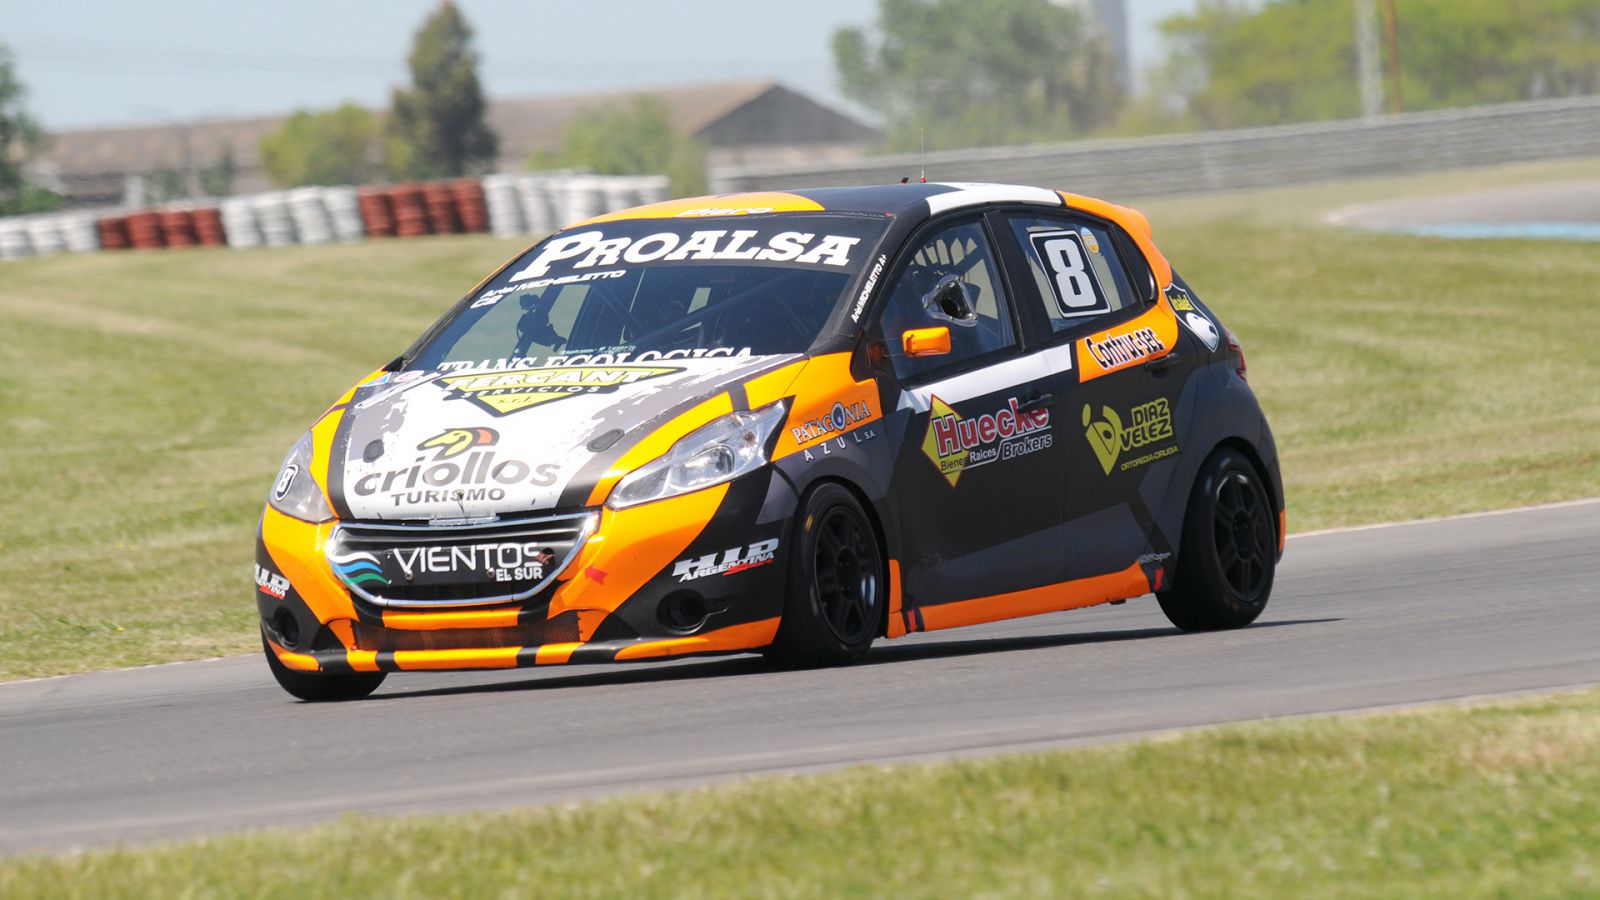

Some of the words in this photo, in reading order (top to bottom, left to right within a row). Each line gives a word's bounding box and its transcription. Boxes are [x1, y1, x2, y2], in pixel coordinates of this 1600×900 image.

[509, 230, 861, 282] PROALSA
[517, 270, 627, 291] MICHELETTO
[859, 263, 883, 310] MICHELETTO
[1043, 238, 1097, 308] 8
[1085, 326, 1166, 370] Contruc-sec
[462, 385, 601, 398] SERVICIOS
[791, 400, 871, 445] PATAGONIA
[932, 396, 1050, 457] Huecke
[1132, 399, 1169, 427] DIAZ
[970, 448, 997, 462] Raices
[1002, 434, 1053, 460] Brokers
[1120, 418, 1173, 451] VELEZ
[276, 466, 296, 493] 8
[354, 451, 562, 497] criollos
[390, 487, 506, 506] TURISMO
[393, 542, 544, 573] VIENTOS
[679, 551, 775, 583] ARGENTINA
[496, 568, 513, 582] EL
[516, 566, 543, 580] SUR
